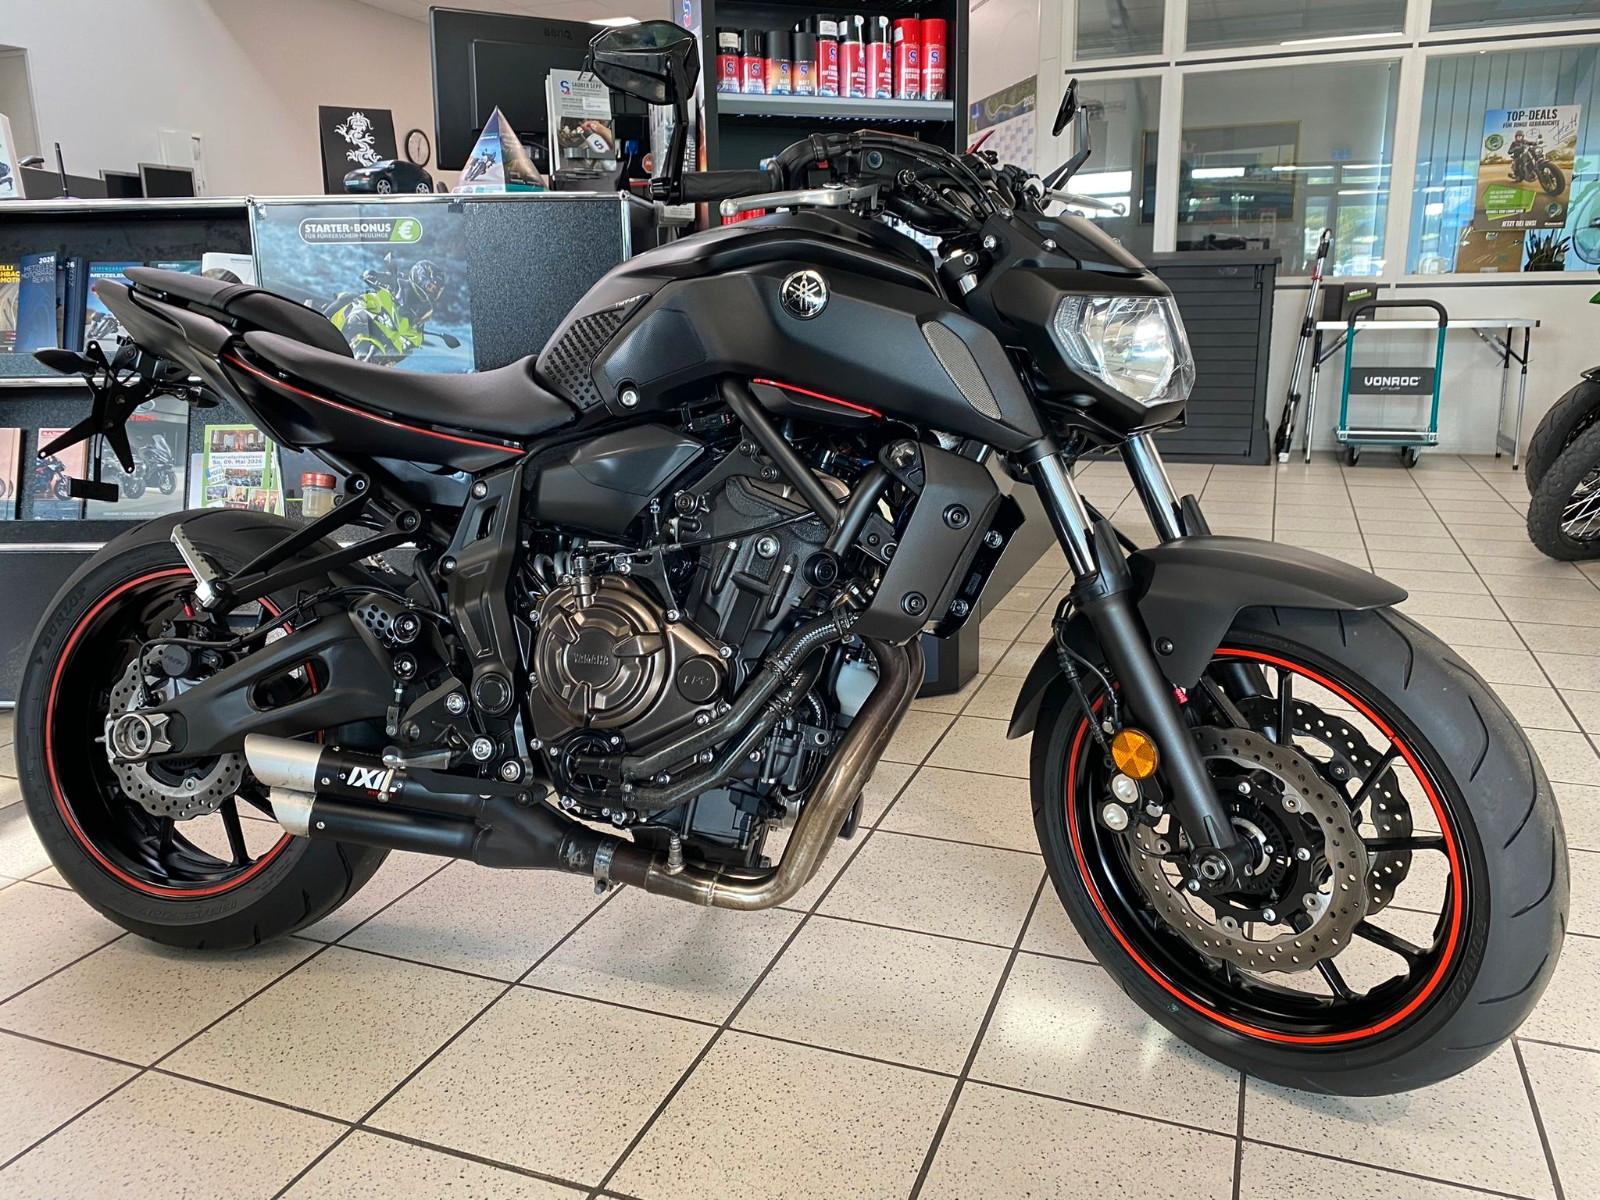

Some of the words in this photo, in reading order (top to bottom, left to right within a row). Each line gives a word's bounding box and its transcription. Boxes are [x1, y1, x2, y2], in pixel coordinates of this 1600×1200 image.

[1506, 108, 1558, 121] TOP-DEALS
[38, 255, 55, 264] 2026
[1364, 376, 1419, 386] VONROC
[573, 652, 609, 665] YAMAHA
